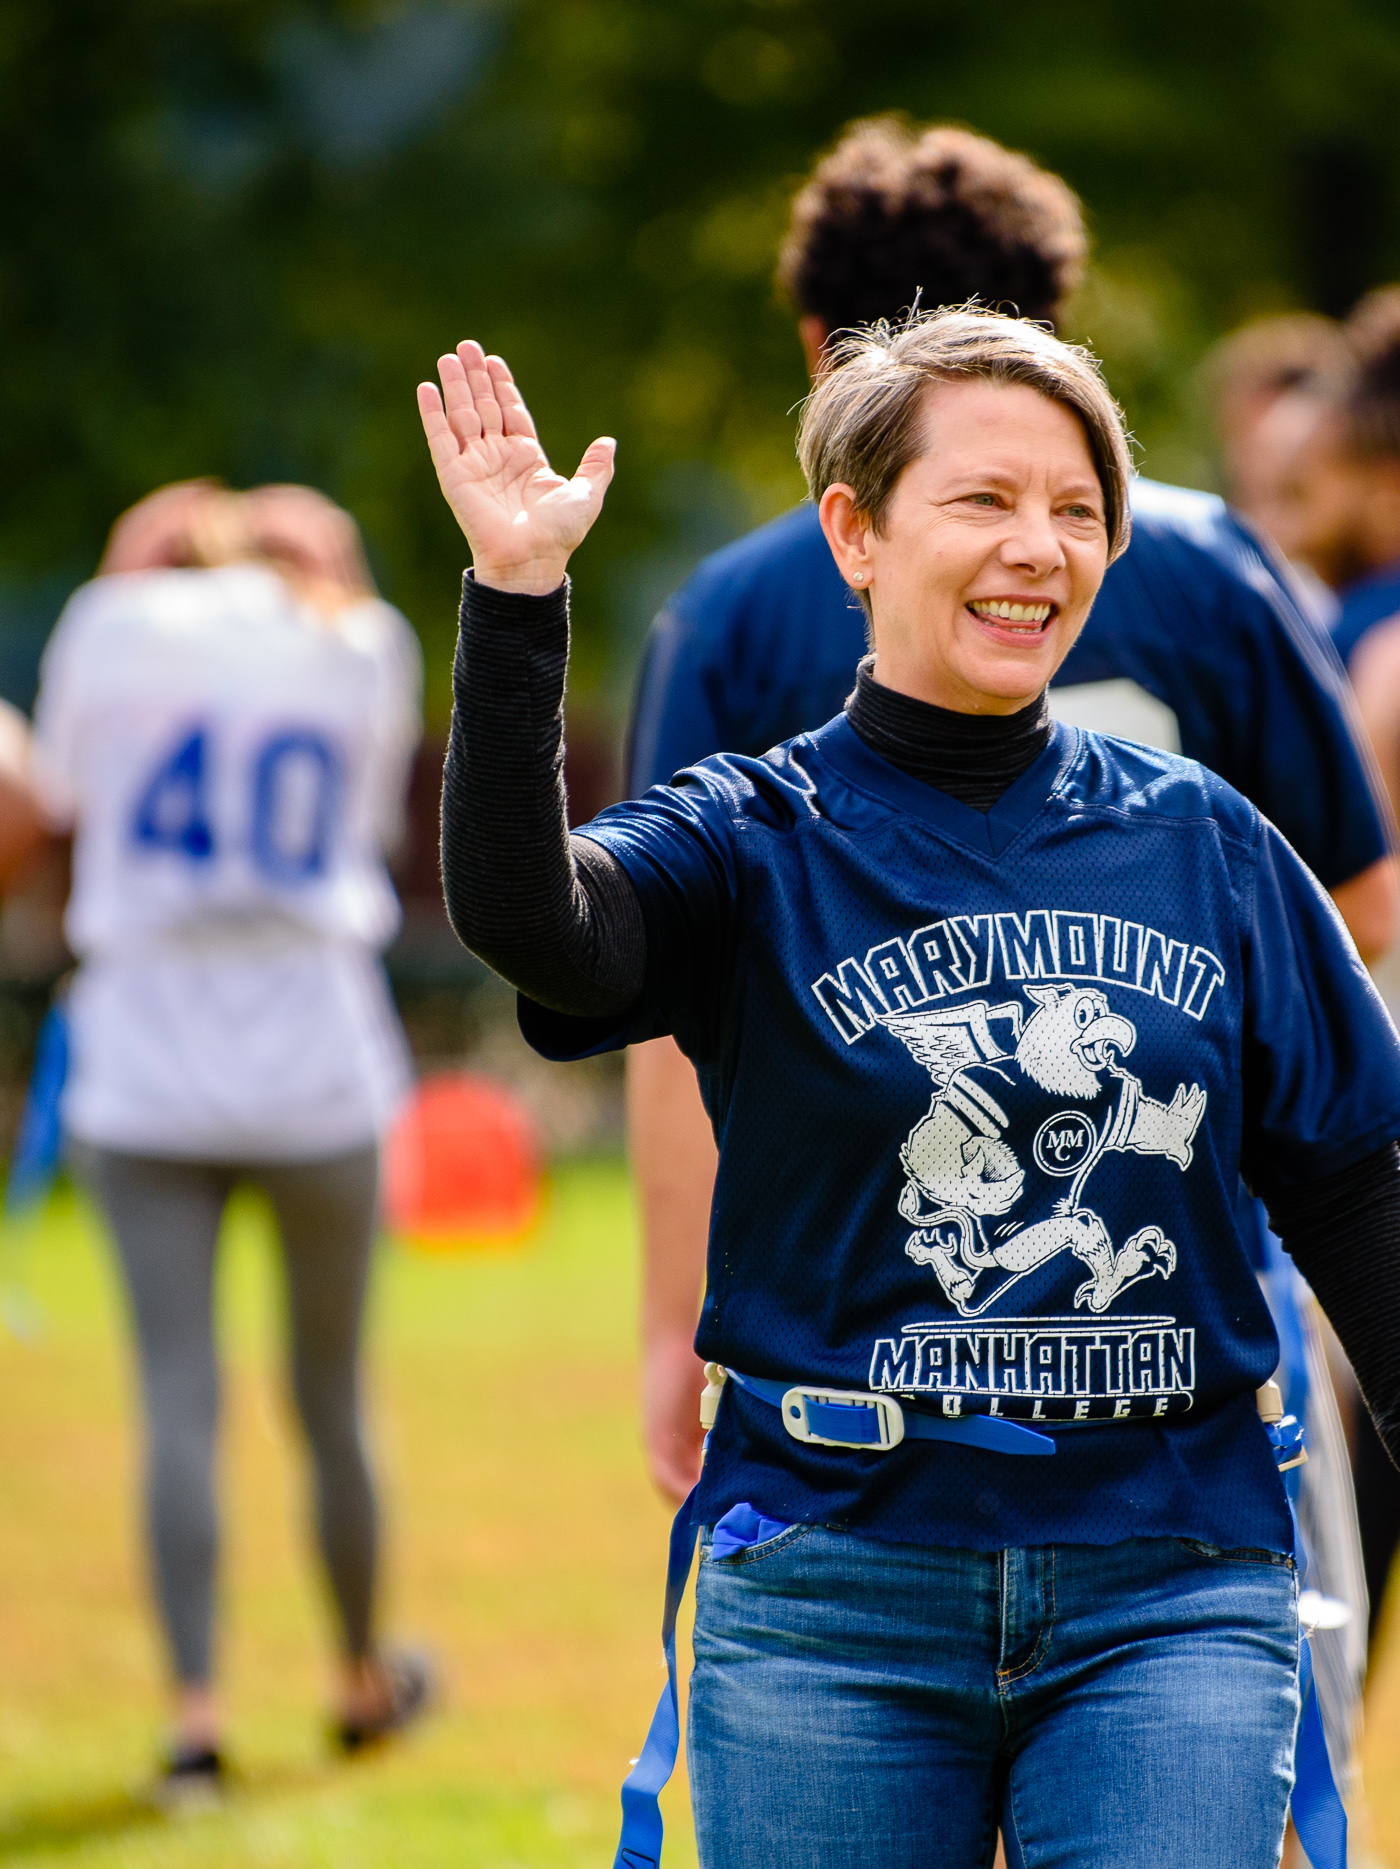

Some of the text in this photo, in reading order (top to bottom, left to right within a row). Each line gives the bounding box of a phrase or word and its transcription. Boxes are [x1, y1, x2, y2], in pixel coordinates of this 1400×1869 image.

[130, 716, 347, 884] 40
[811, 910, 1225, 1045] MARYMOUNT
[869, 1328, 1195, 1392] MANHATTAN
[900, 1393, 1168, 1419] OLLEGE
